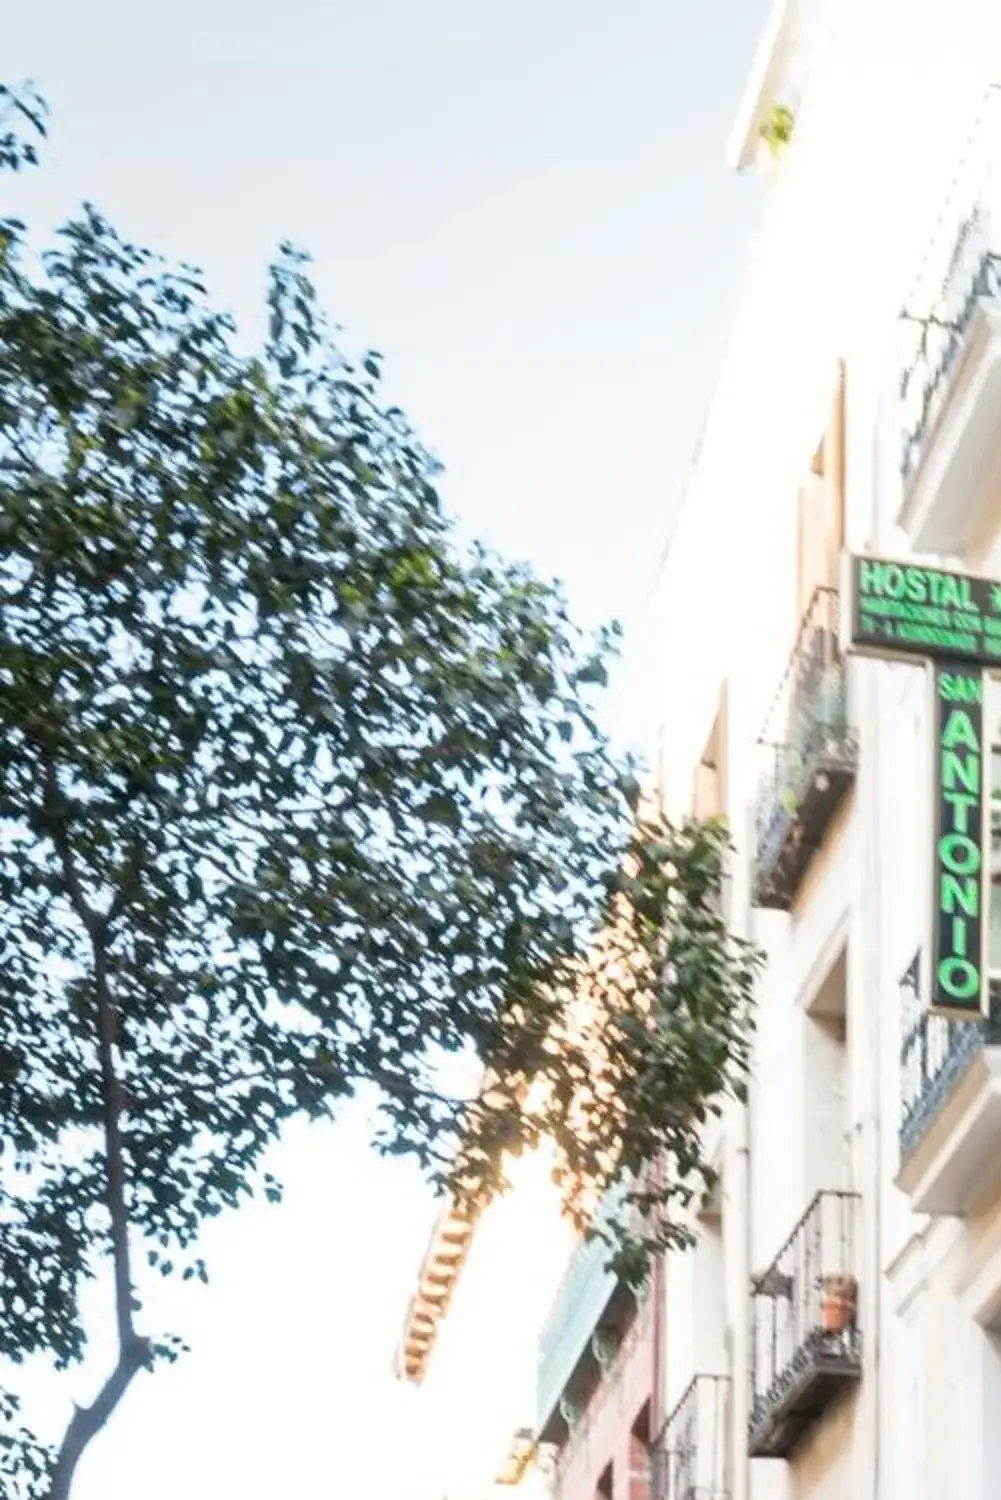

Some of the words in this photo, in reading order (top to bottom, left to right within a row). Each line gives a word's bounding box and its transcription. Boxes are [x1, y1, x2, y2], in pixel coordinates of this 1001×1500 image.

[860, 559, 980, 613] HOSTAL
[937, 672, 983, 704] SAN
[937, 709, 982, 998] ANTONIO
